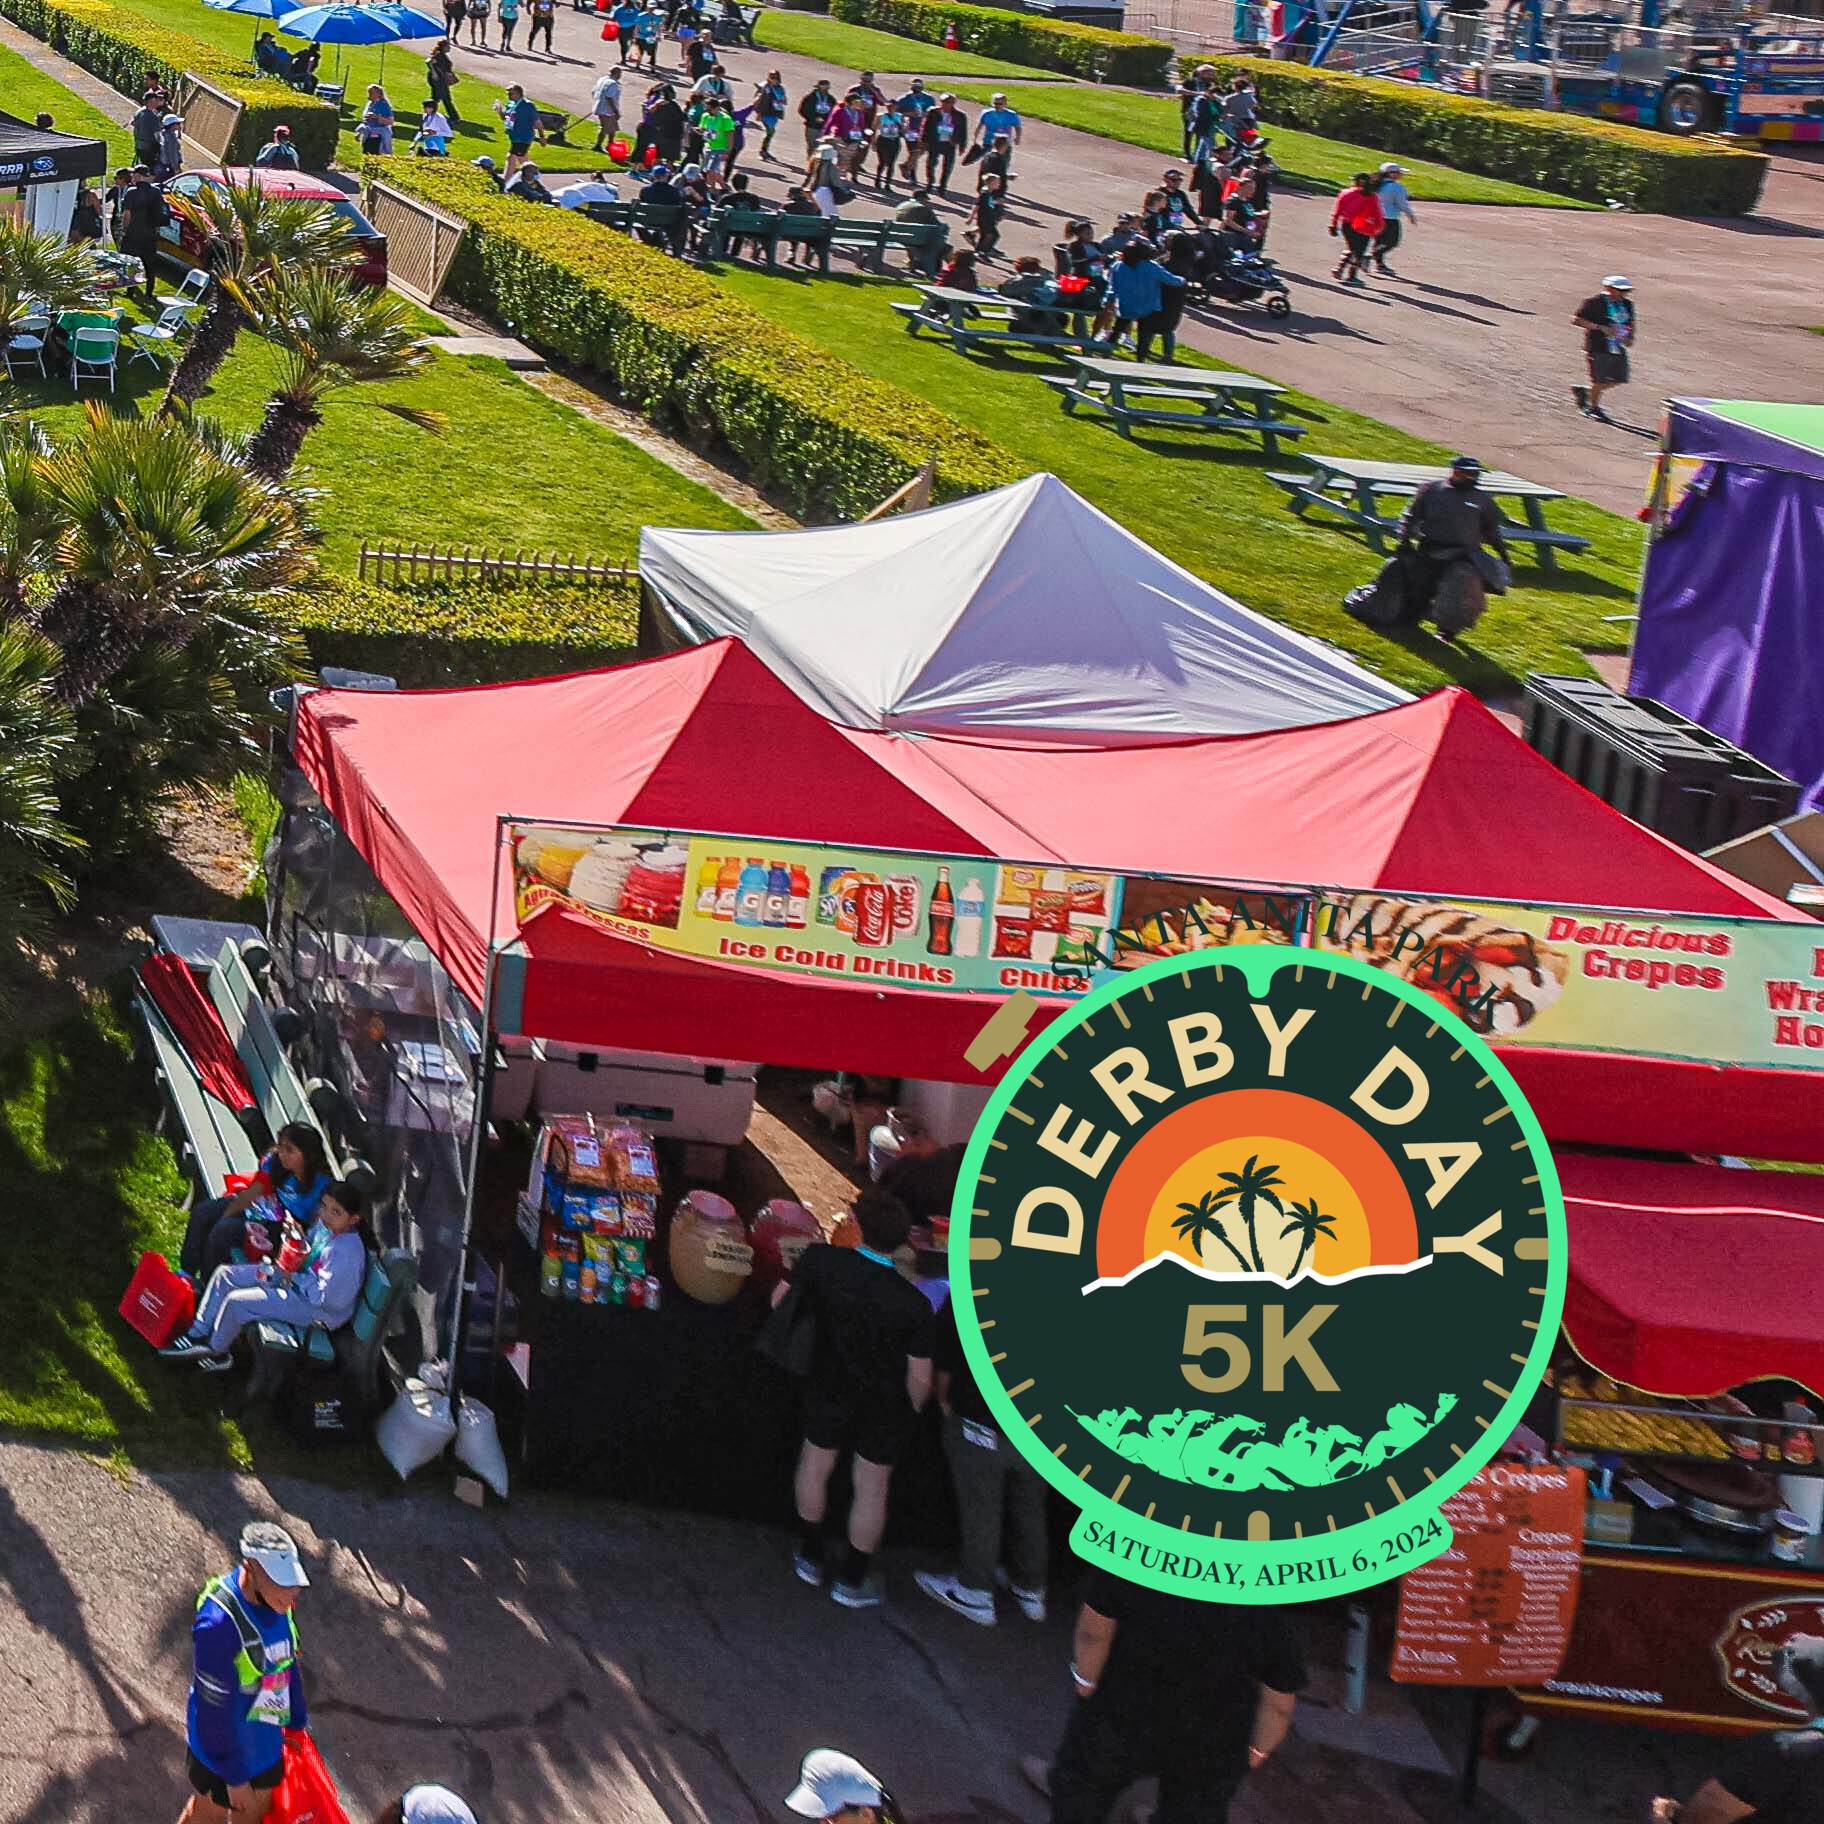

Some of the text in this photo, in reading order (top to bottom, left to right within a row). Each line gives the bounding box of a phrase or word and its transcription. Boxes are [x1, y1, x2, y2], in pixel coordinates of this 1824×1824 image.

[29, 169, 59, 179] SUBARU
[743, 893, 759, 908] G
[767, 895, 782, 910] G
[1547, 915, 1733, 958] Delicious
[719, 937, 954, 985] Ice Cold Drinks
[1583, 949, 1728, 991] Crepes
[999, 966, 1092, 993] Chips
[1490, 1466, 1569, 1493] Crepes
